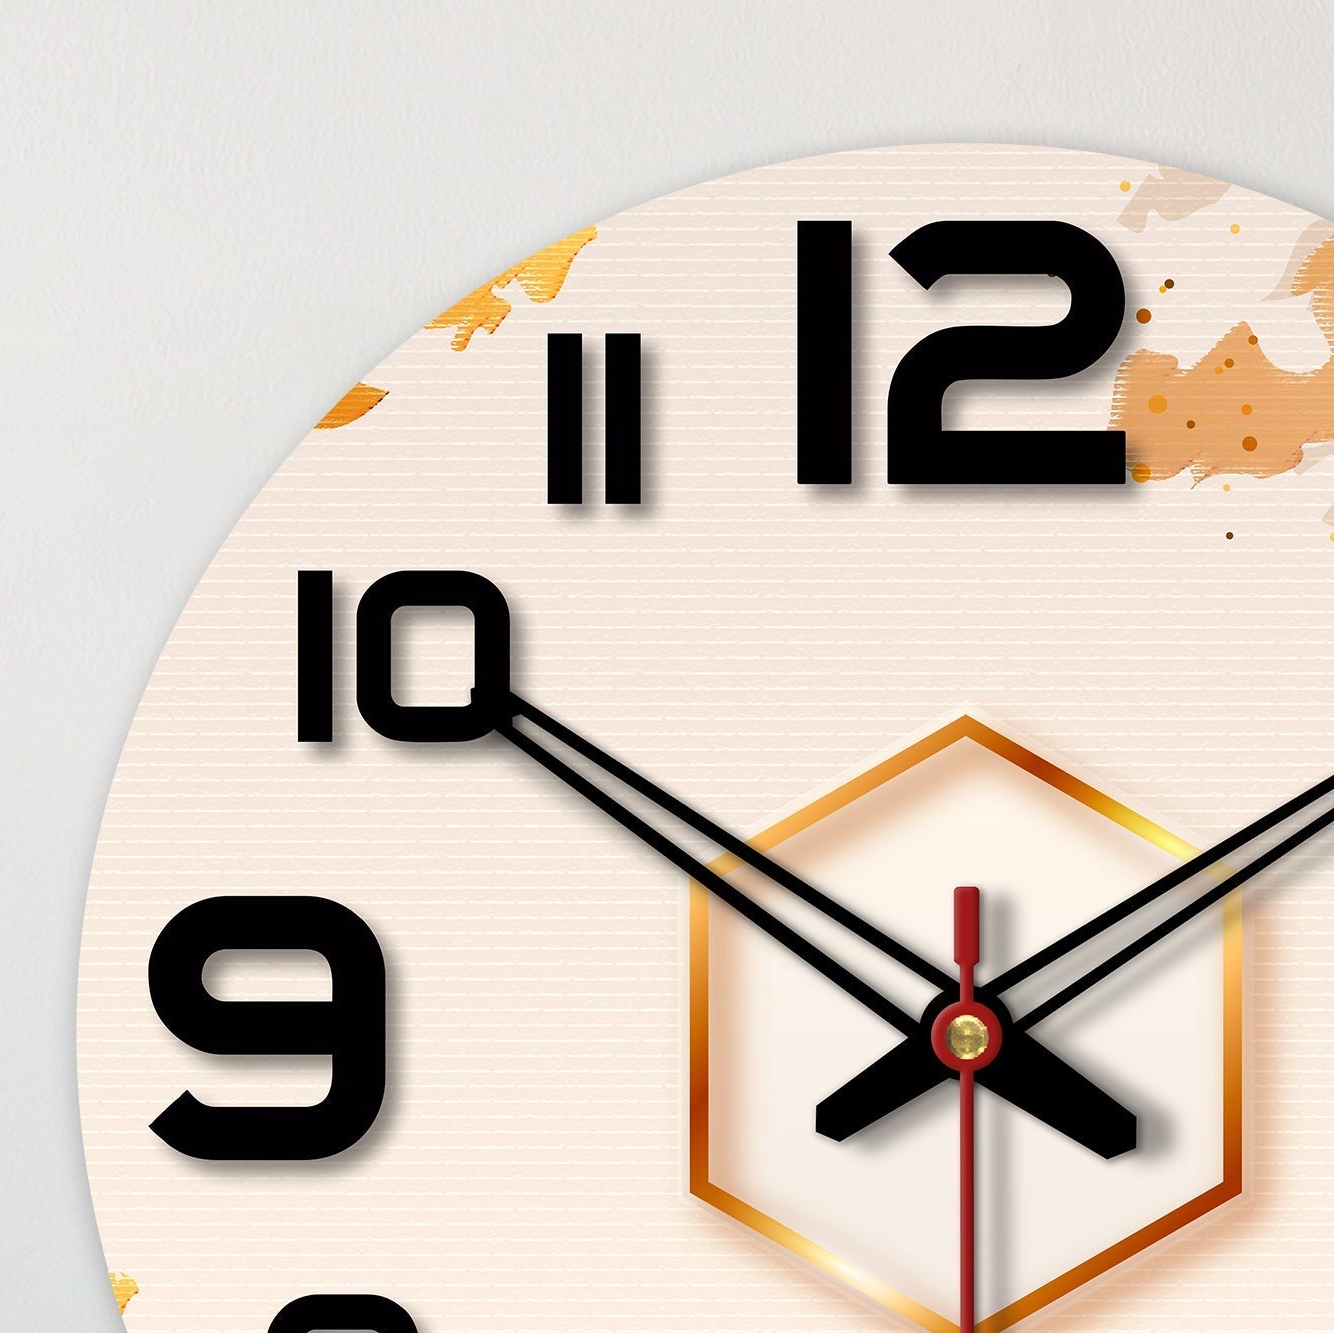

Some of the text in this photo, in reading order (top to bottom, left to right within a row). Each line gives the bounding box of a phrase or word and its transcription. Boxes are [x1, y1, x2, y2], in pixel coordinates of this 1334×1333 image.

[548, 334, 642, 504] 11
[798, 221, 1127, 484] 12
[298, 571, 510, 742] 10
[149, 896, 385, 1160] 9
